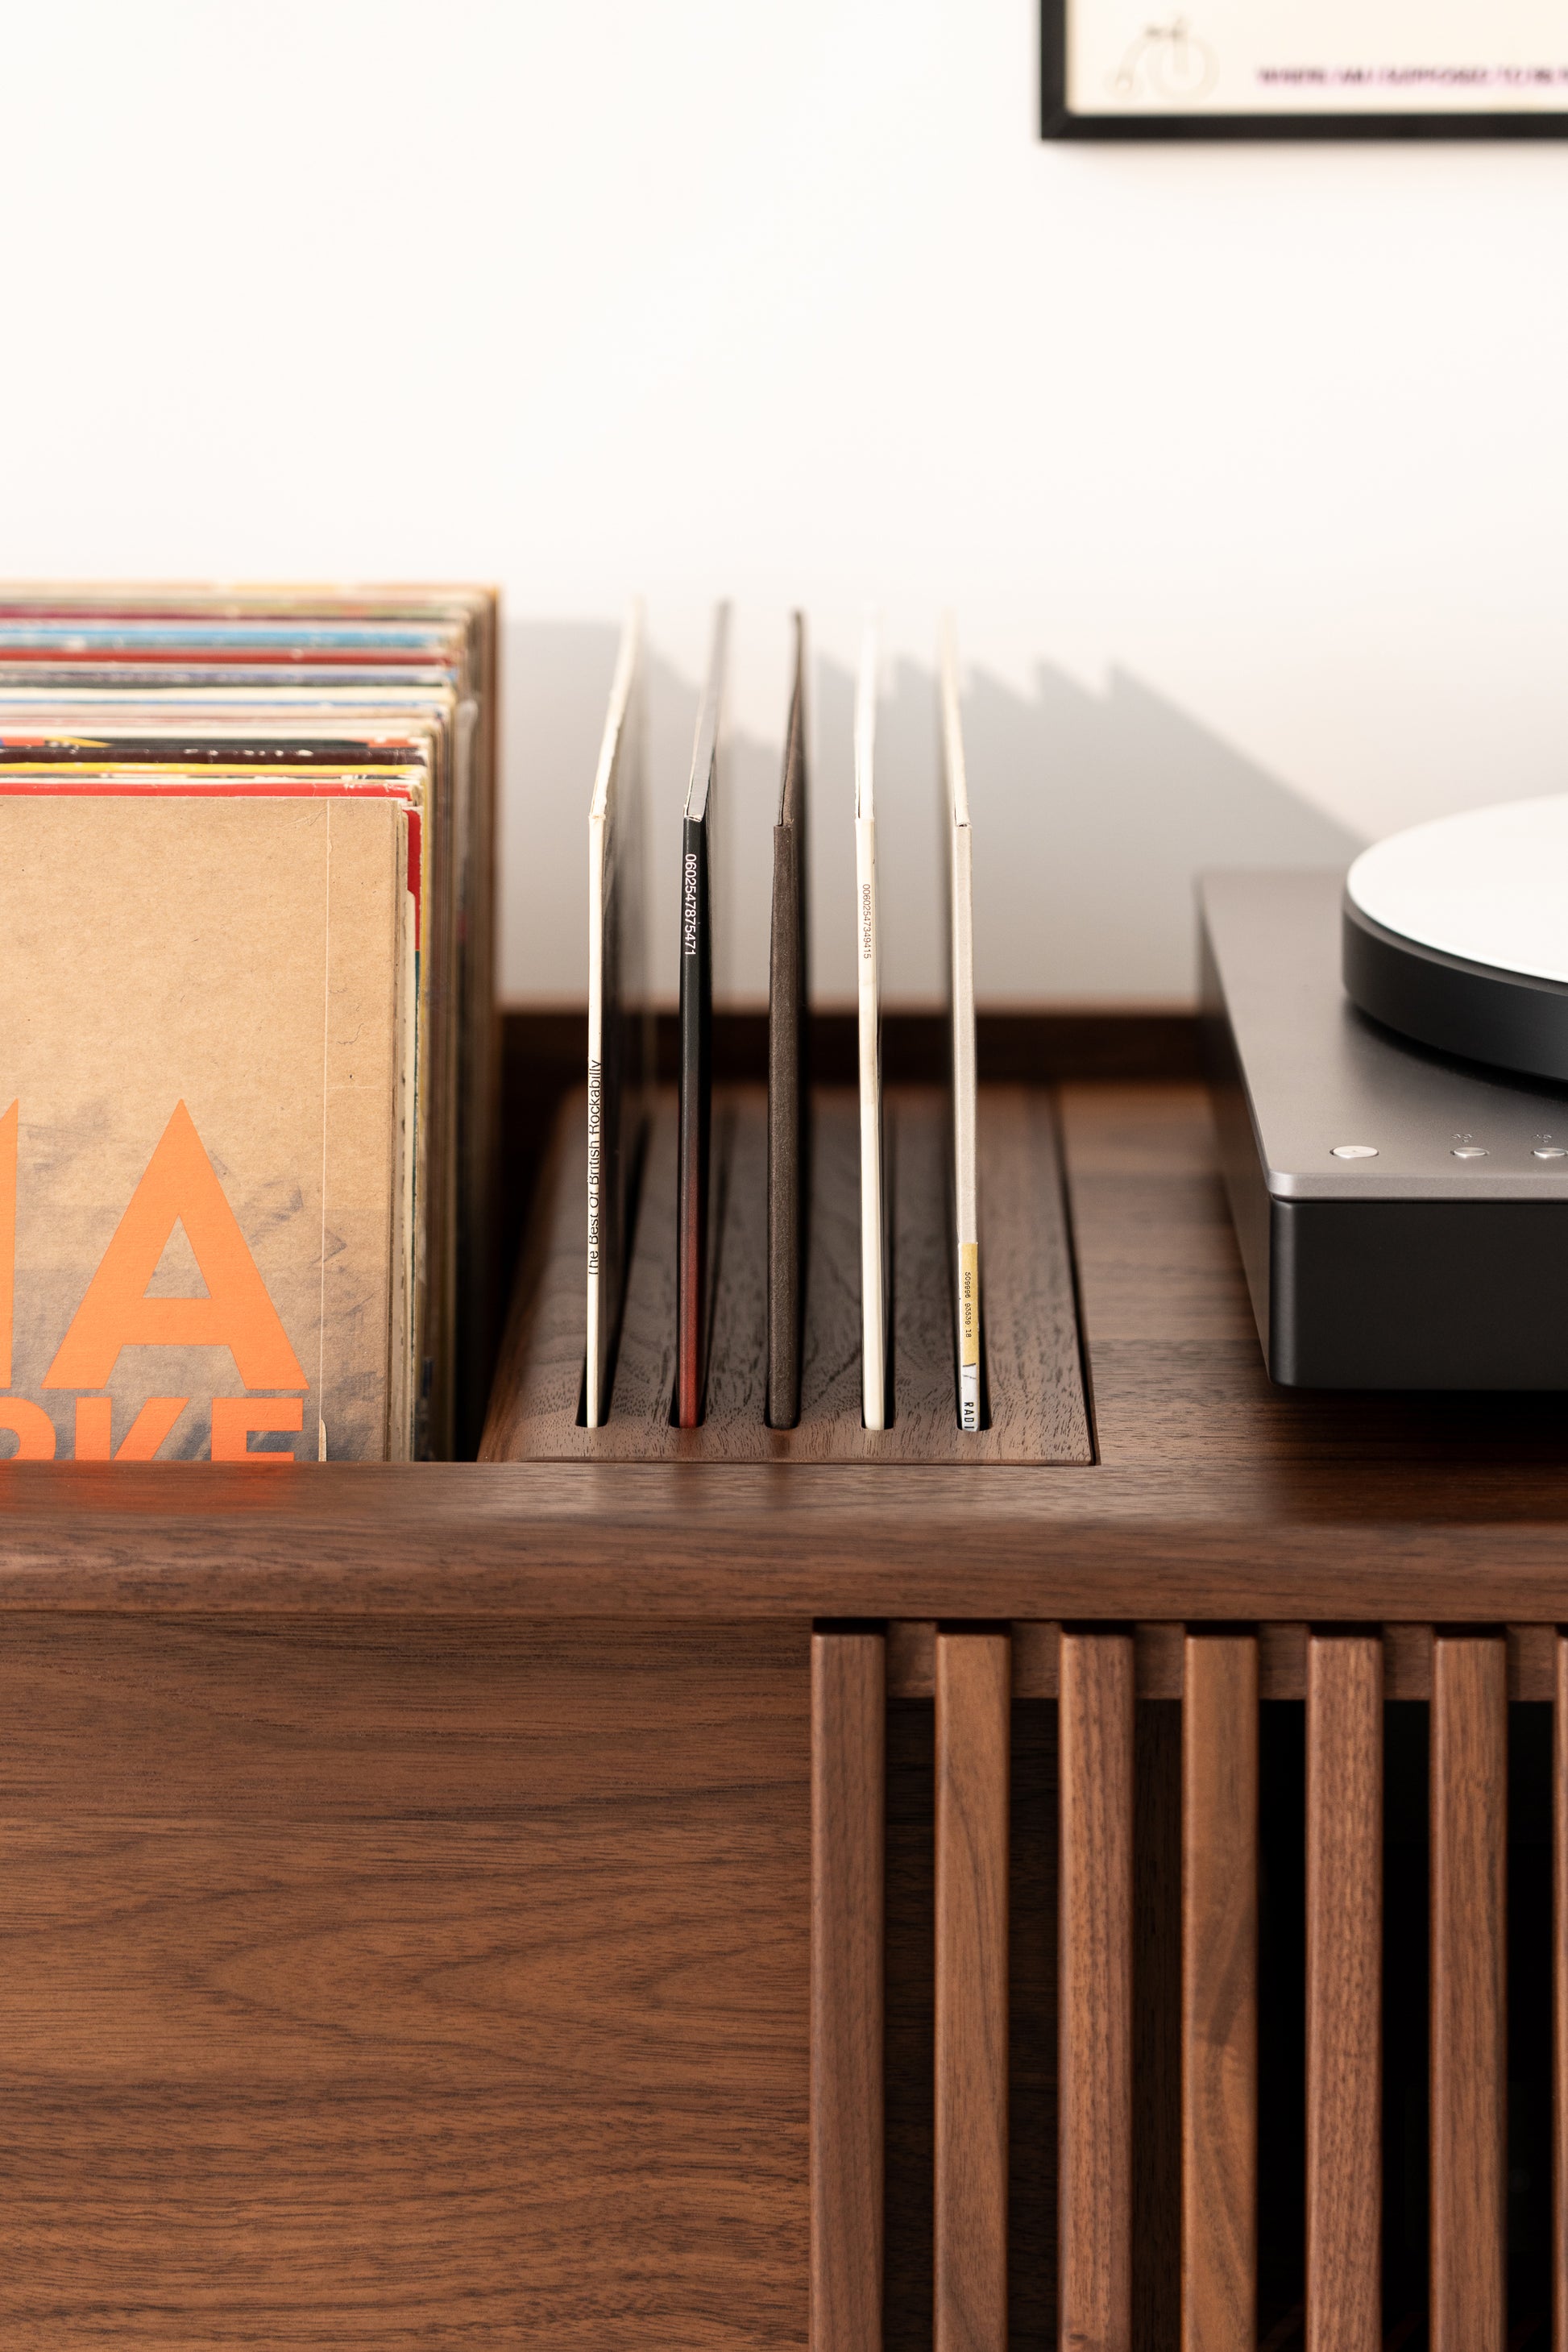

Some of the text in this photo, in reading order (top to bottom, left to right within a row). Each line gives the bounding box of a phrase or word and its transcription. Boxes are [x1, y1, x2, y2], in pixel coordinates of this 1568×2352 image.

[685, 853, 697, 955] 0602547875471
[862, 883, 872, 959] 00602547349415
[589, 1060, 601, 1135] Rockabilly
[589, 1140, 599, 1185] British
[589, 1213, 599, 1245] Best
[588, 1251, 599, 1275] The
[964, 1402, 975, 1429] RADI
